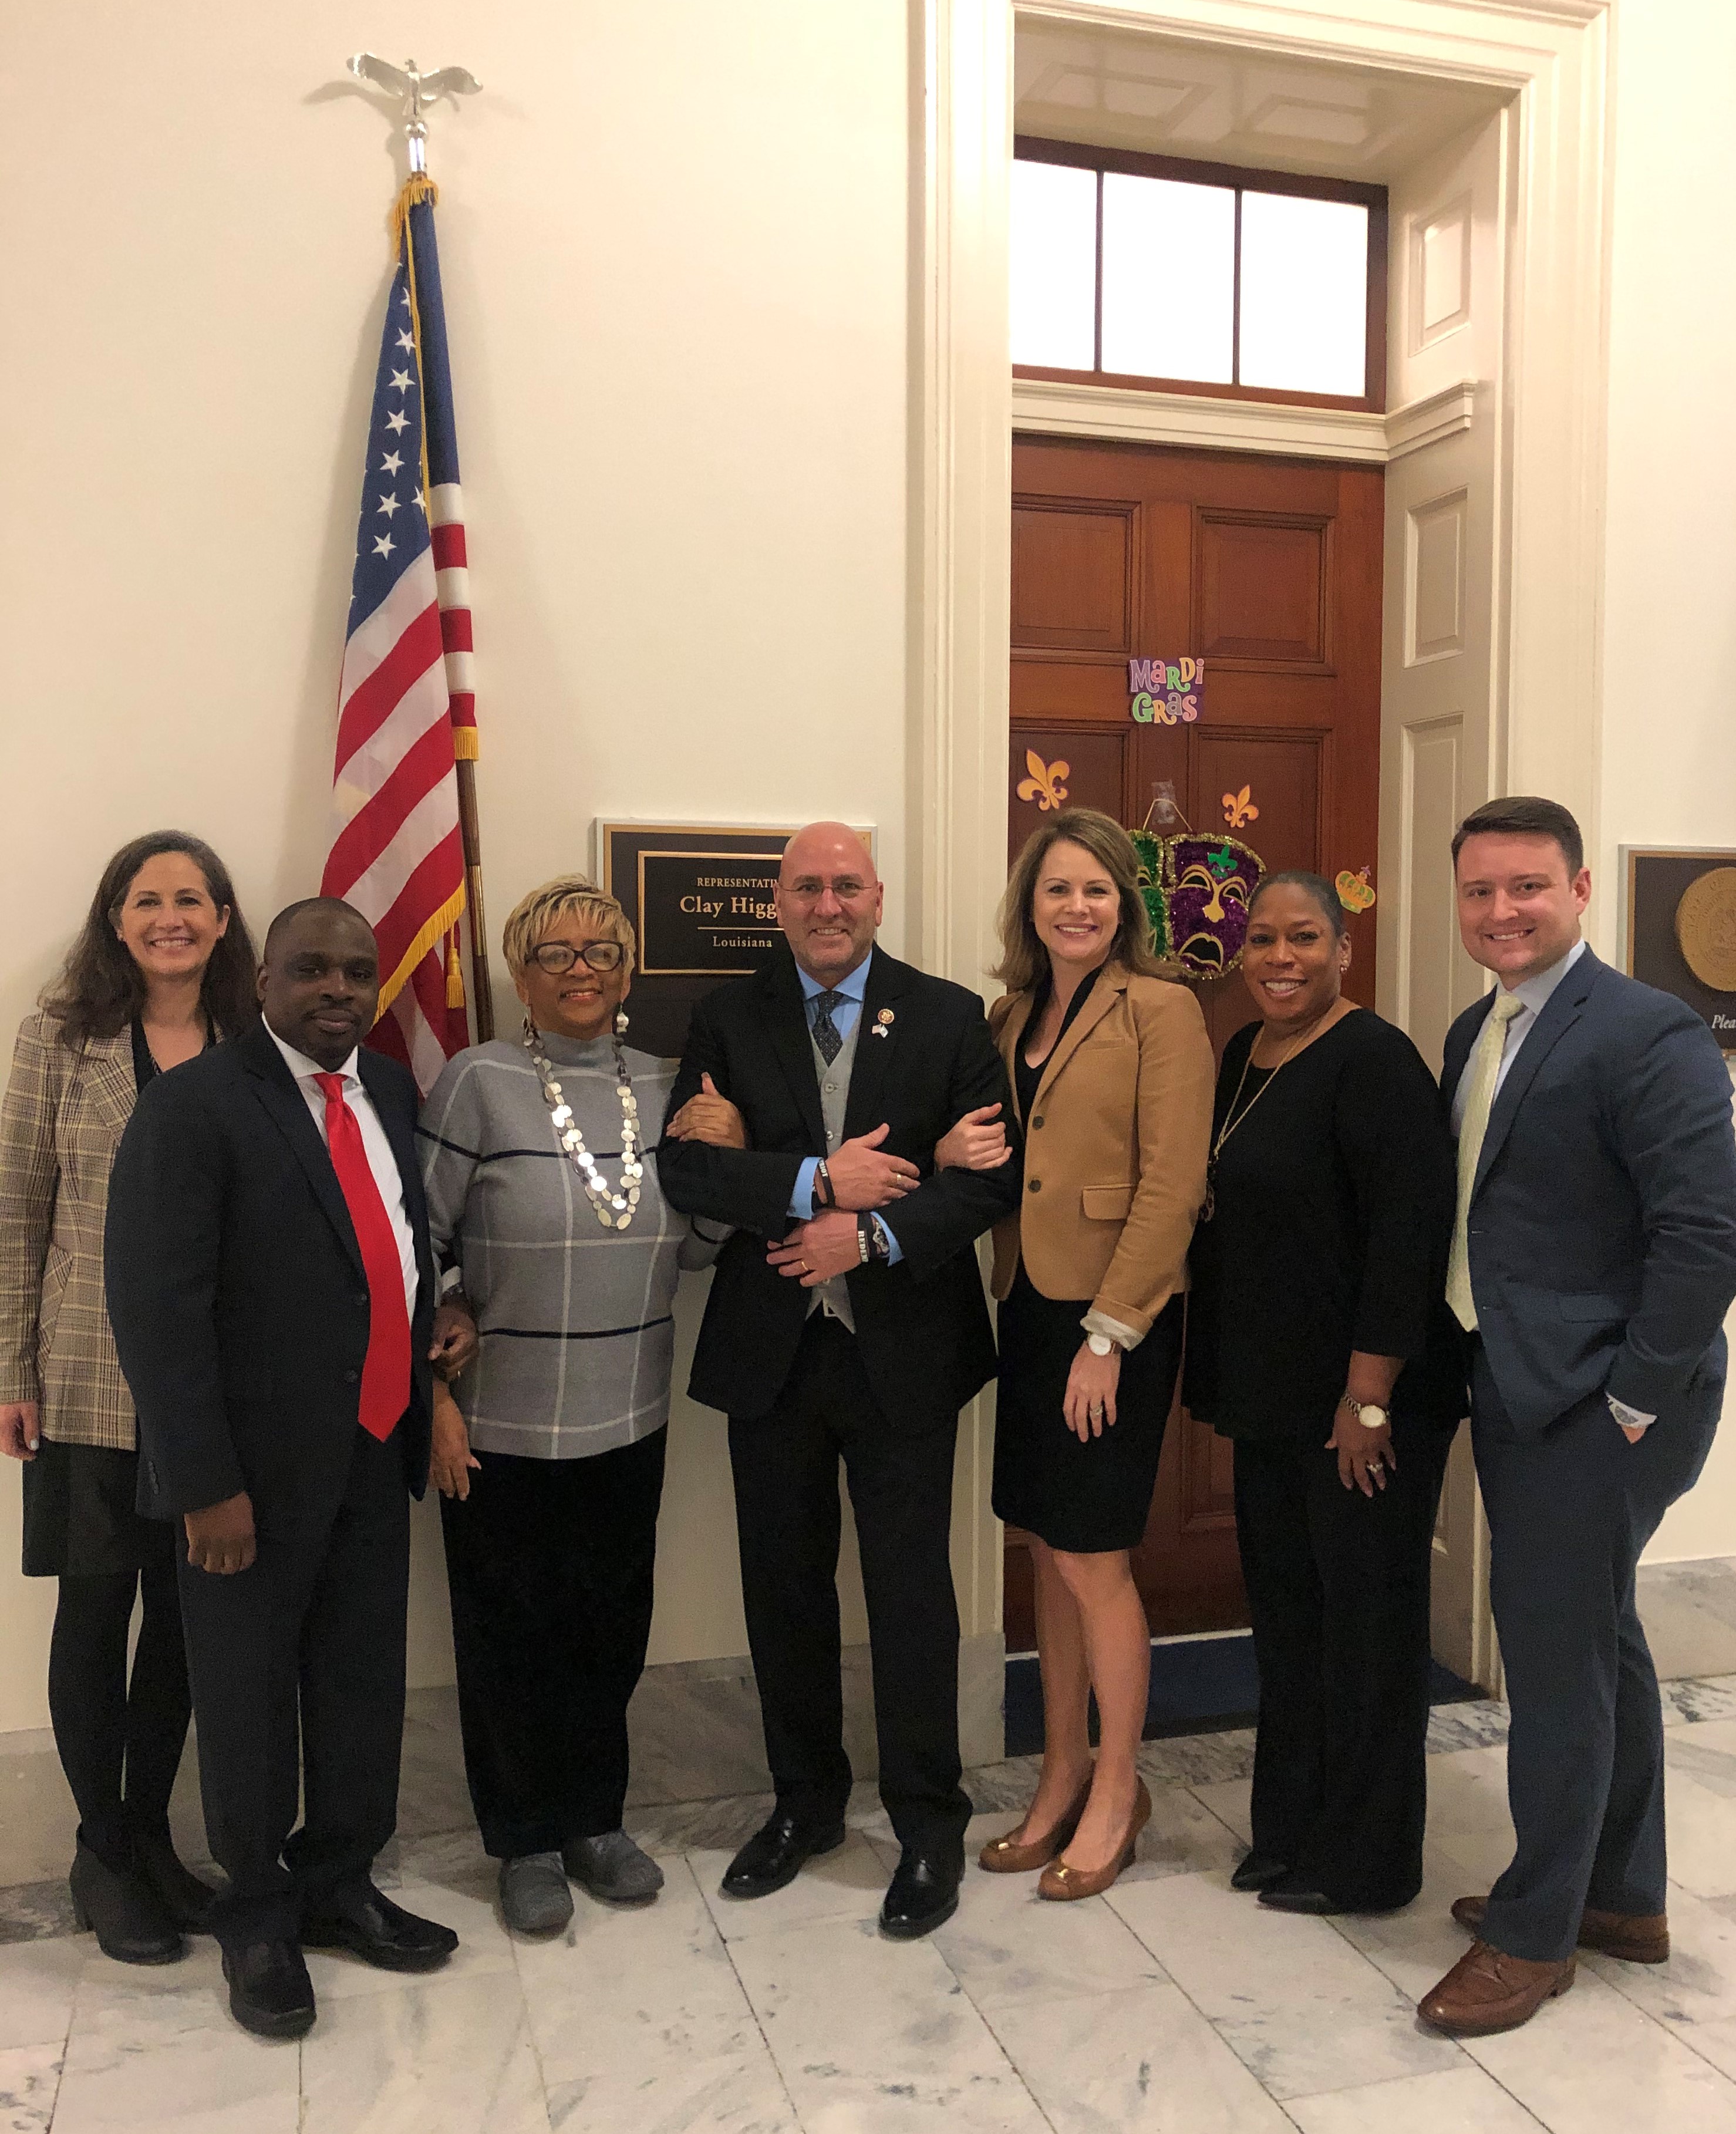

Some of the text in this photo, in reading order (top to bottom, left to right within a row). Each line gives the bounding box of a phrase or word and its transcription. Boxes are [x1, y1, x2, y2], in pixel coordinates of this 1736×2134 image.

[697, 878, 777, 888] REPRESENTATI
[680, 896, 724, 918] Clay
[713, 936, 773, 948] Louisiana
